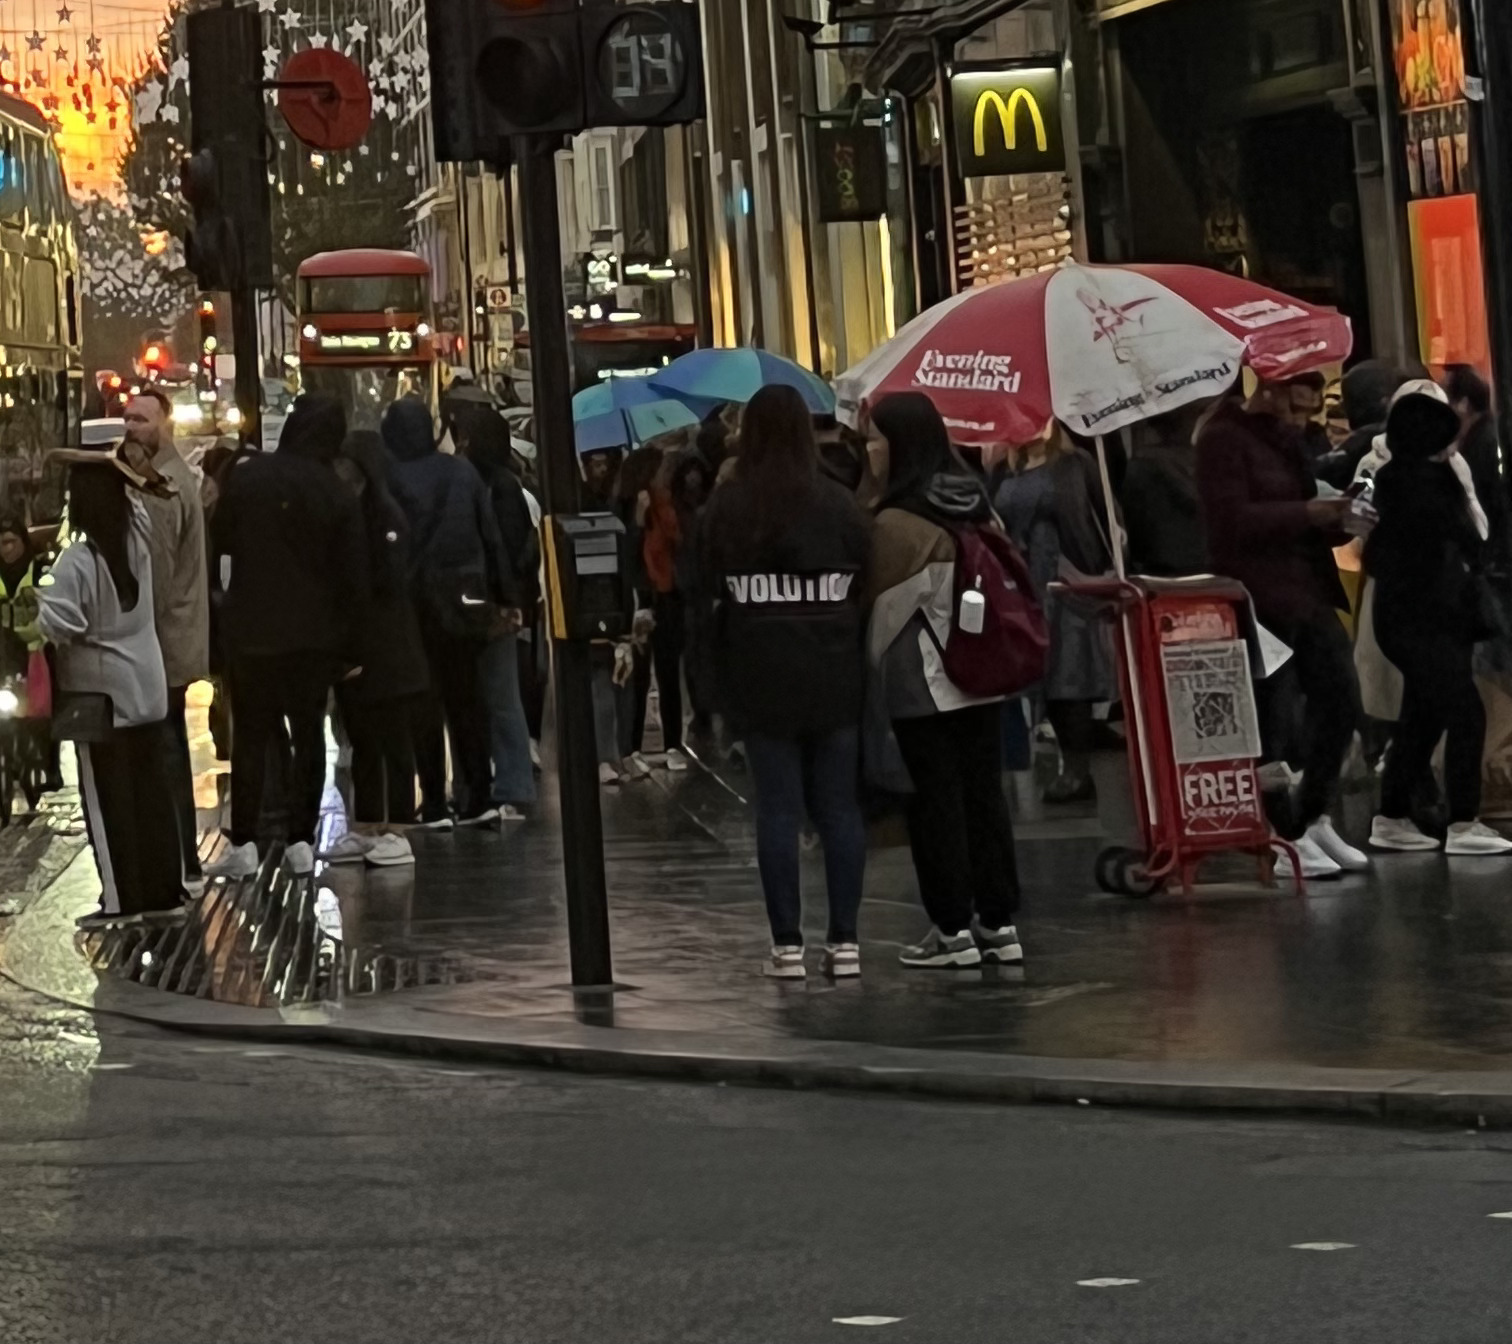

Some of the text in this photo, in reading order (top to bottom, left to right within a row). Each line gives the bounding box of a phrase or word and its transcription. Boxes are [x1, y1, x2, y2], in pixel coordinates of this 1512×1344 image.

[919, 349, 1012, 374] Evening
[911, 368, 1022, 394] Standard
[1184, 768, 1255, 808] FREE
